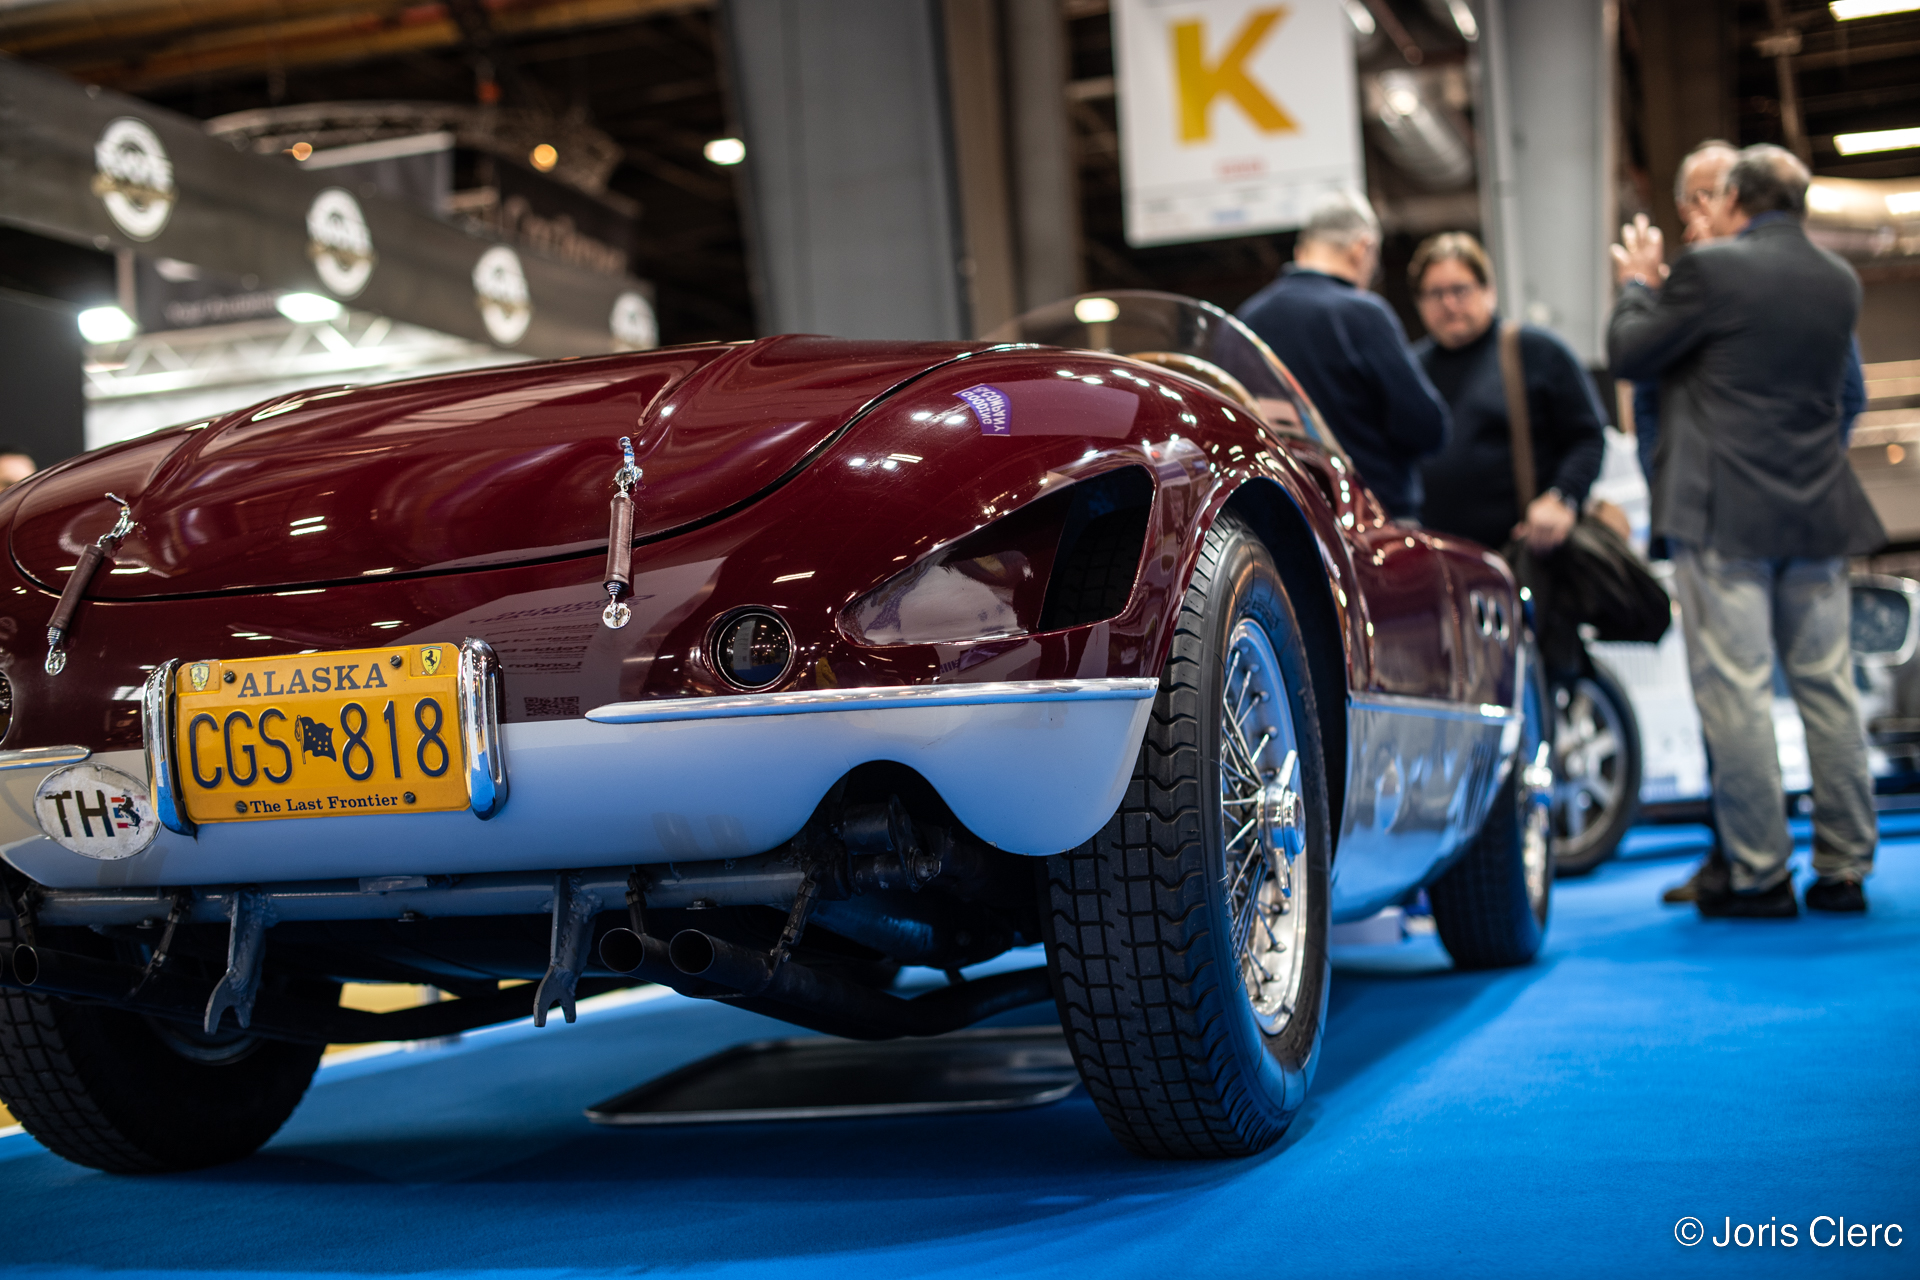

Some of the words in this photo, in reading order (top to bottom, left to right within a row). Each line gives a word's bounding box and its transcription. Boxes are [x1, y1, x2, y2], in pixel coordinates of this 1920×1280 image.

[1170, 3, 1302, 146] K
[237, 663, 388, 698] ALASKA
[189, 708, 293, 789] CGS
[339, 697, 450, 781] 818
[250, 800, 282, 814] The
[285, 799, 323, 812] Last
[329, 794, 398, 810] Frontier
